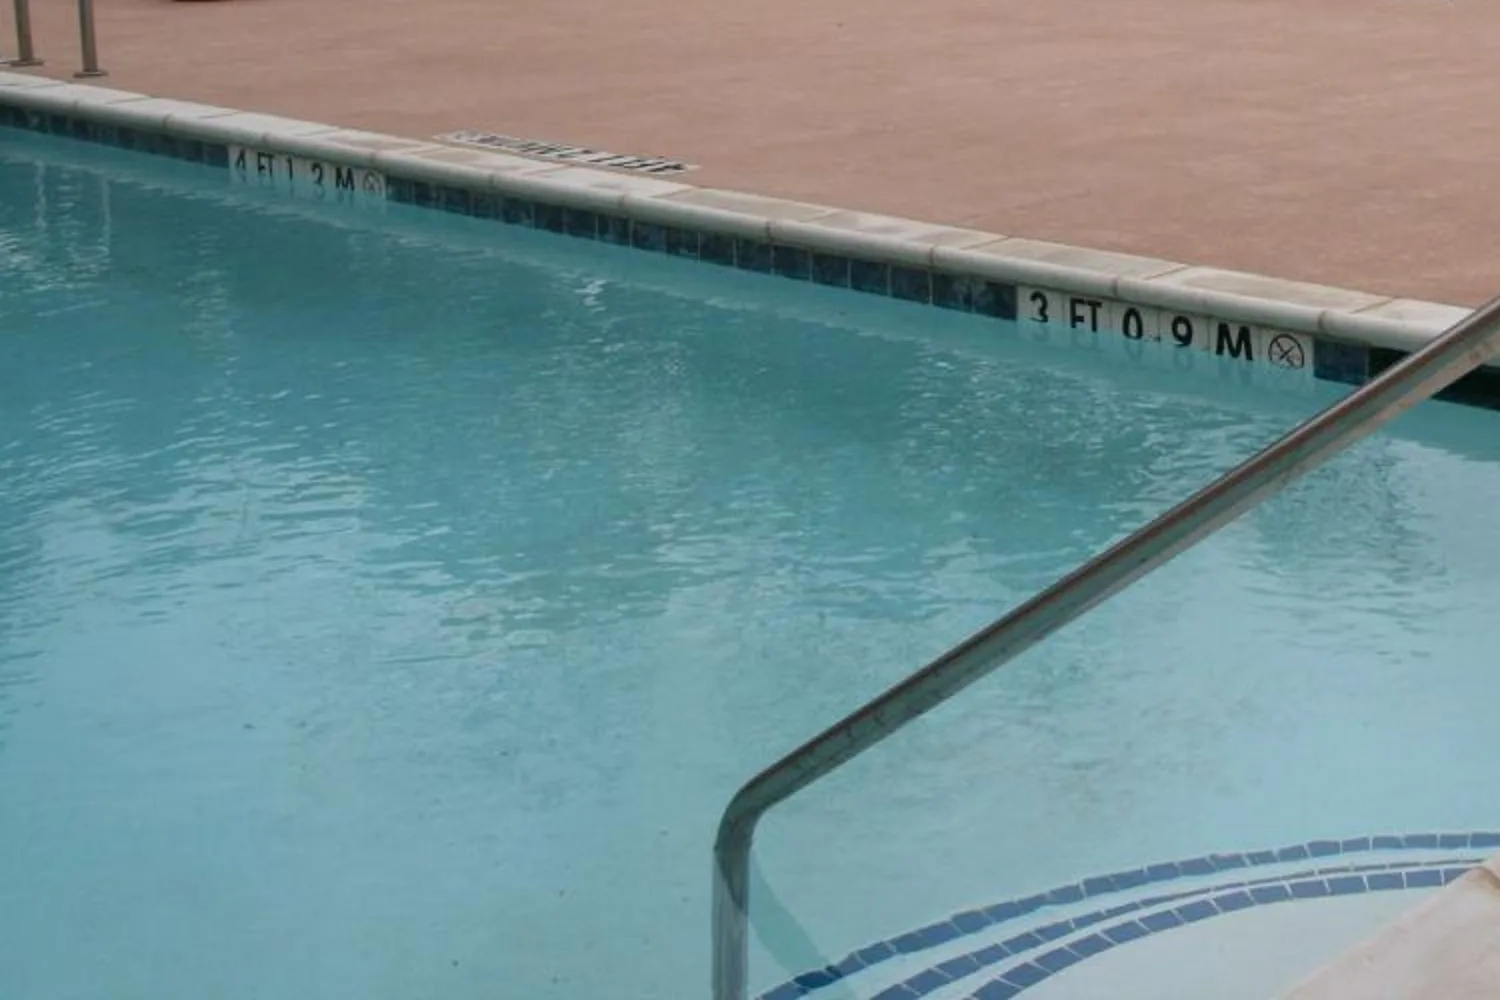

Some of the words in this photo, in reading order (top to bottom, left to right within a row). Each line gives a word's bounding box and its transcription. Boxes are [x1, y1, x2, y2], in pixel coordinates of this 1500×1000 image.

[1030, 291, 1049, 323] 3
[1069, 298, 1103, 333] FT
[1215, 322, 1254, 361] M
